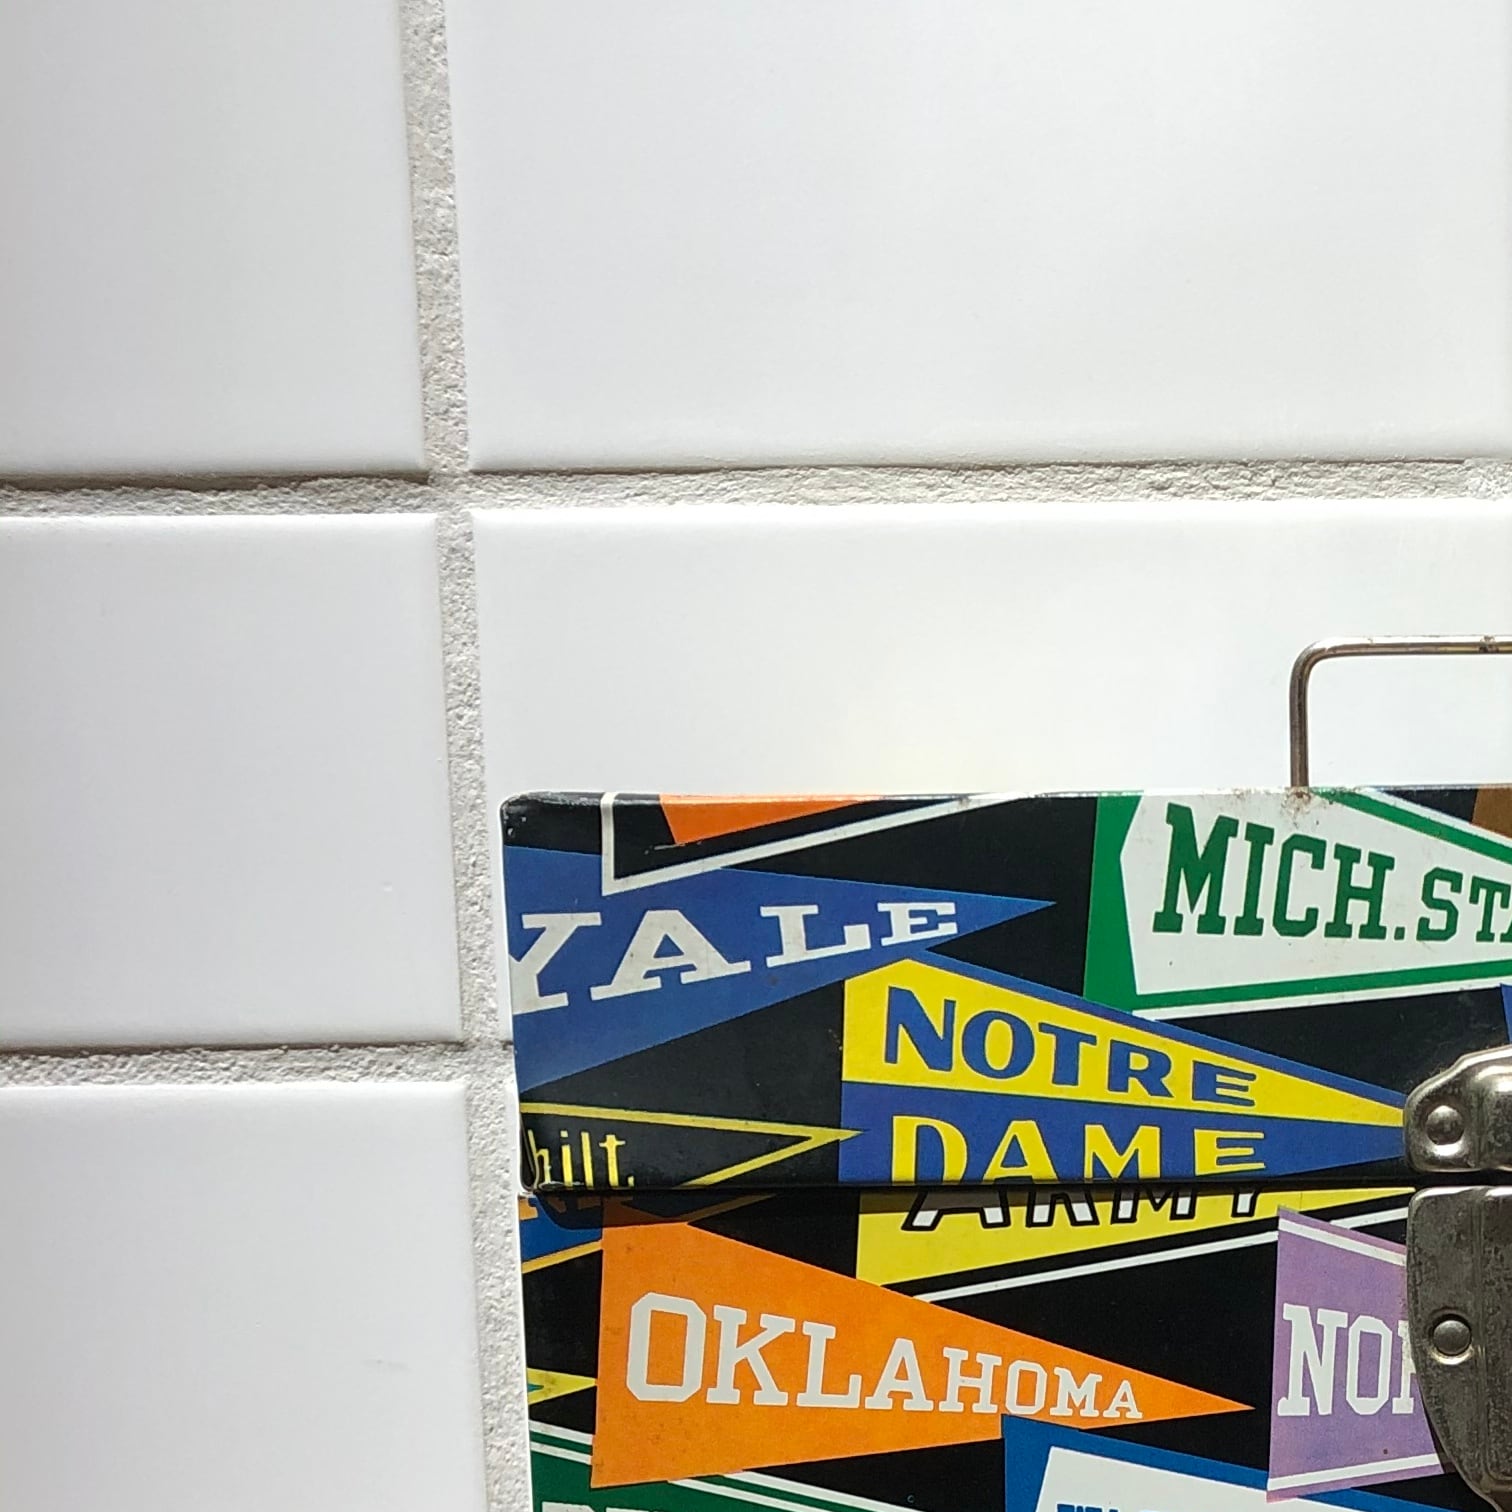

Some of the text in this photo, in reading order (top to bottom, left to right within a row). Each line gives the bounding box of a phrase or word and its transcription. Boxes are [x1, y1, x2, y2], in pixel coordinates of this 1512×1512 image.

[510, 902, 958, 1015] YALE
[884, 986, 1256, 1107] NOTRE
[891, 1115, 1265, 1184] DAME
[626, 1292, 1143, 1419] OKLAHOMA
